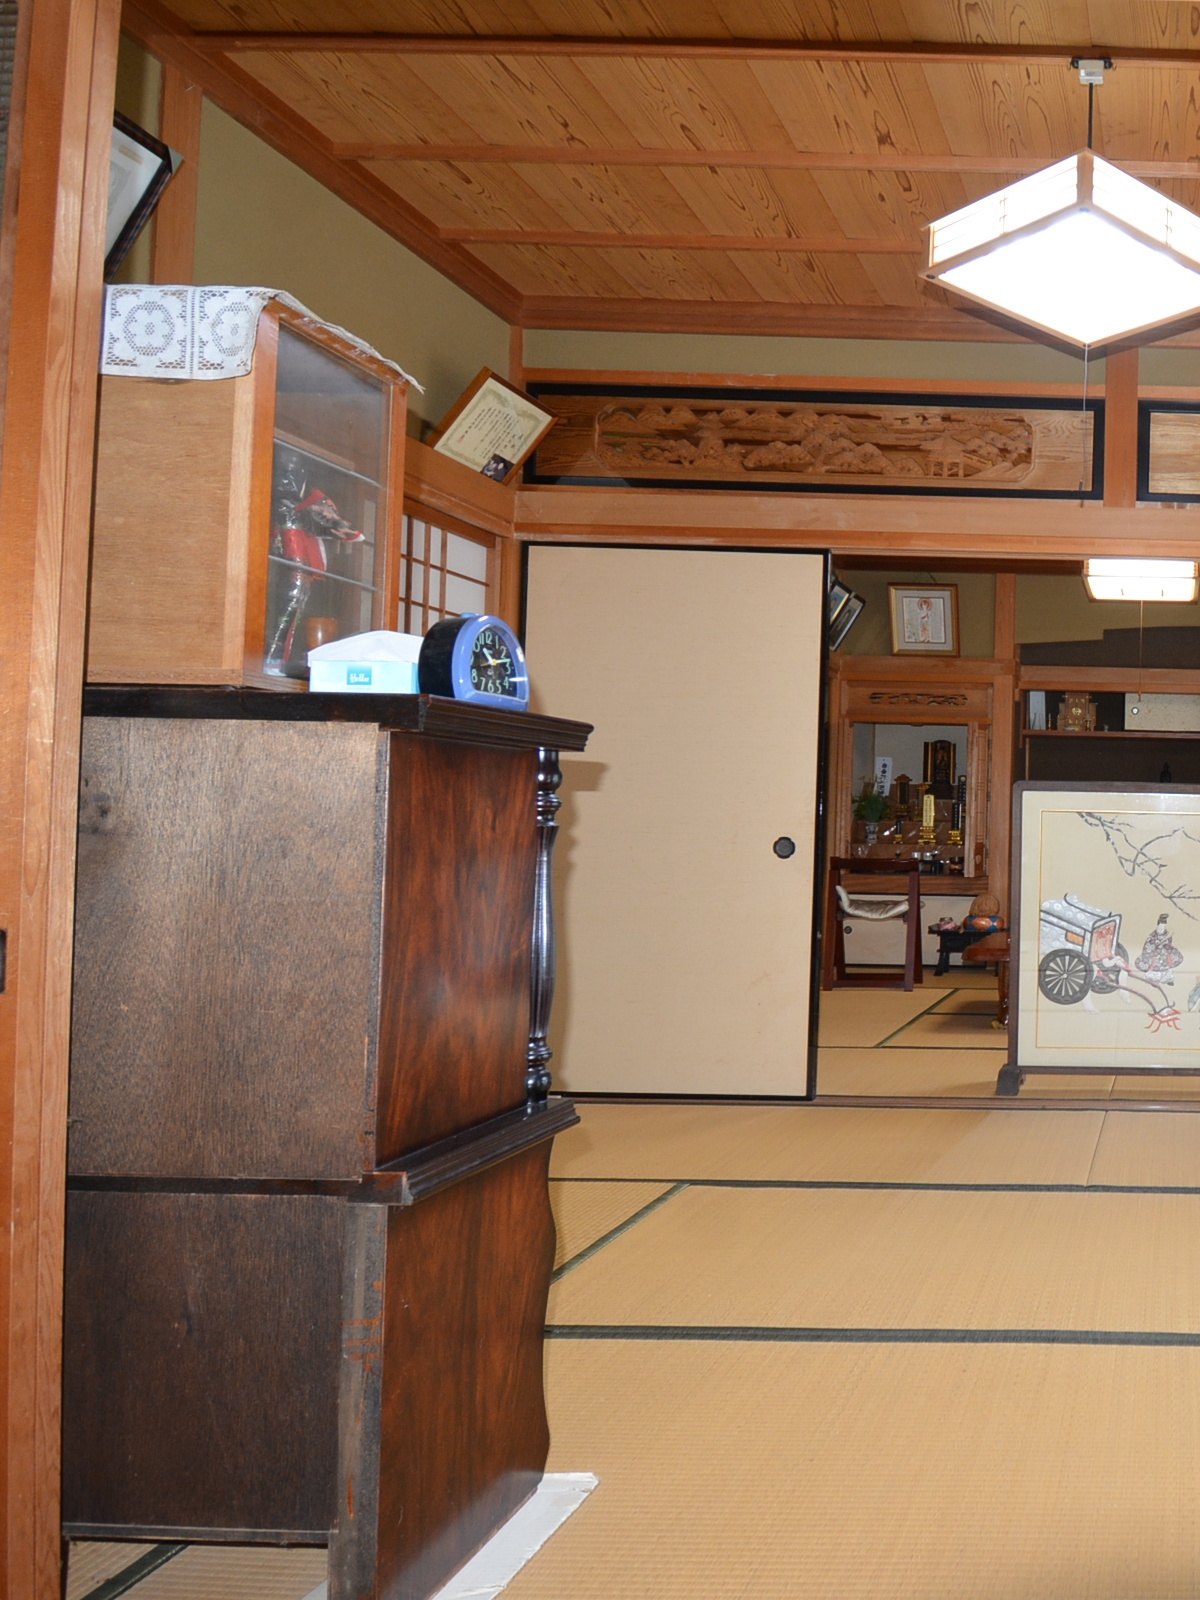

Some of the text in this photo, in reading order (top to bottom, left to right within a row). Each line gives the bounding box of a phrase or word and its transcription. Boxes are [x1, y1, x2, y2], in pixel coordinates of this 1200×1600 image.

[485, 630, 493, 645] 12
[495, 635, 499, 649] 1
[500, 646, 507, 659] 2
[506, 659, 511, 675] 3
[349, 672, 370, 683] Hello
[471, 668, 478, 683] 8
[503, 676, 509, 689] 4
[480, 677, 486, 691] 7
[487, 680, 494, 693] 6
[496, 680, 502, 694] 5
